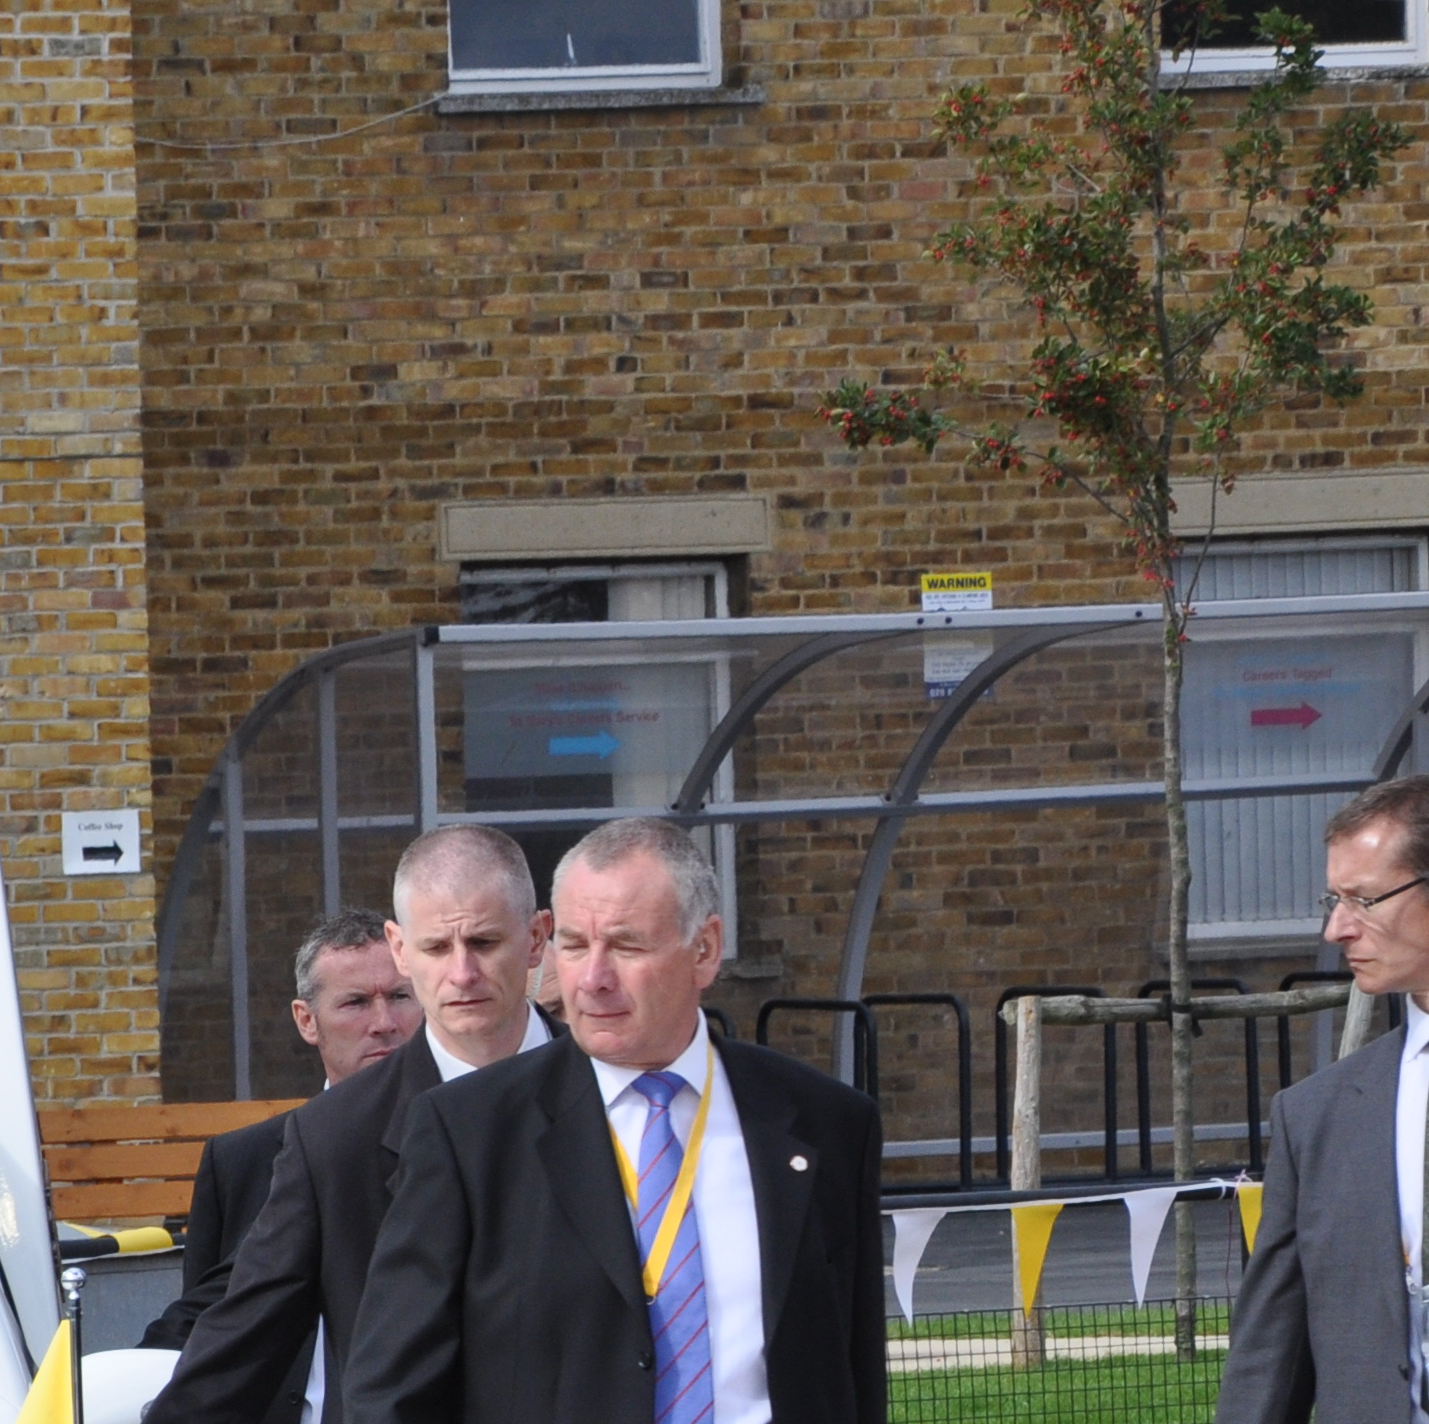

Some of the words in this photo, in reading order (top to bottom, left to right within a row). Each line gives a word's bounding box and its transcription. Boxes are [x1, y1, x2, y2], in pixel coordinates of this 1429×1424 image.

[927, 576, 987, 589] WARNING
[78, 823, 102, 831] Coffee
[104, 822, 123, 831] Shop
